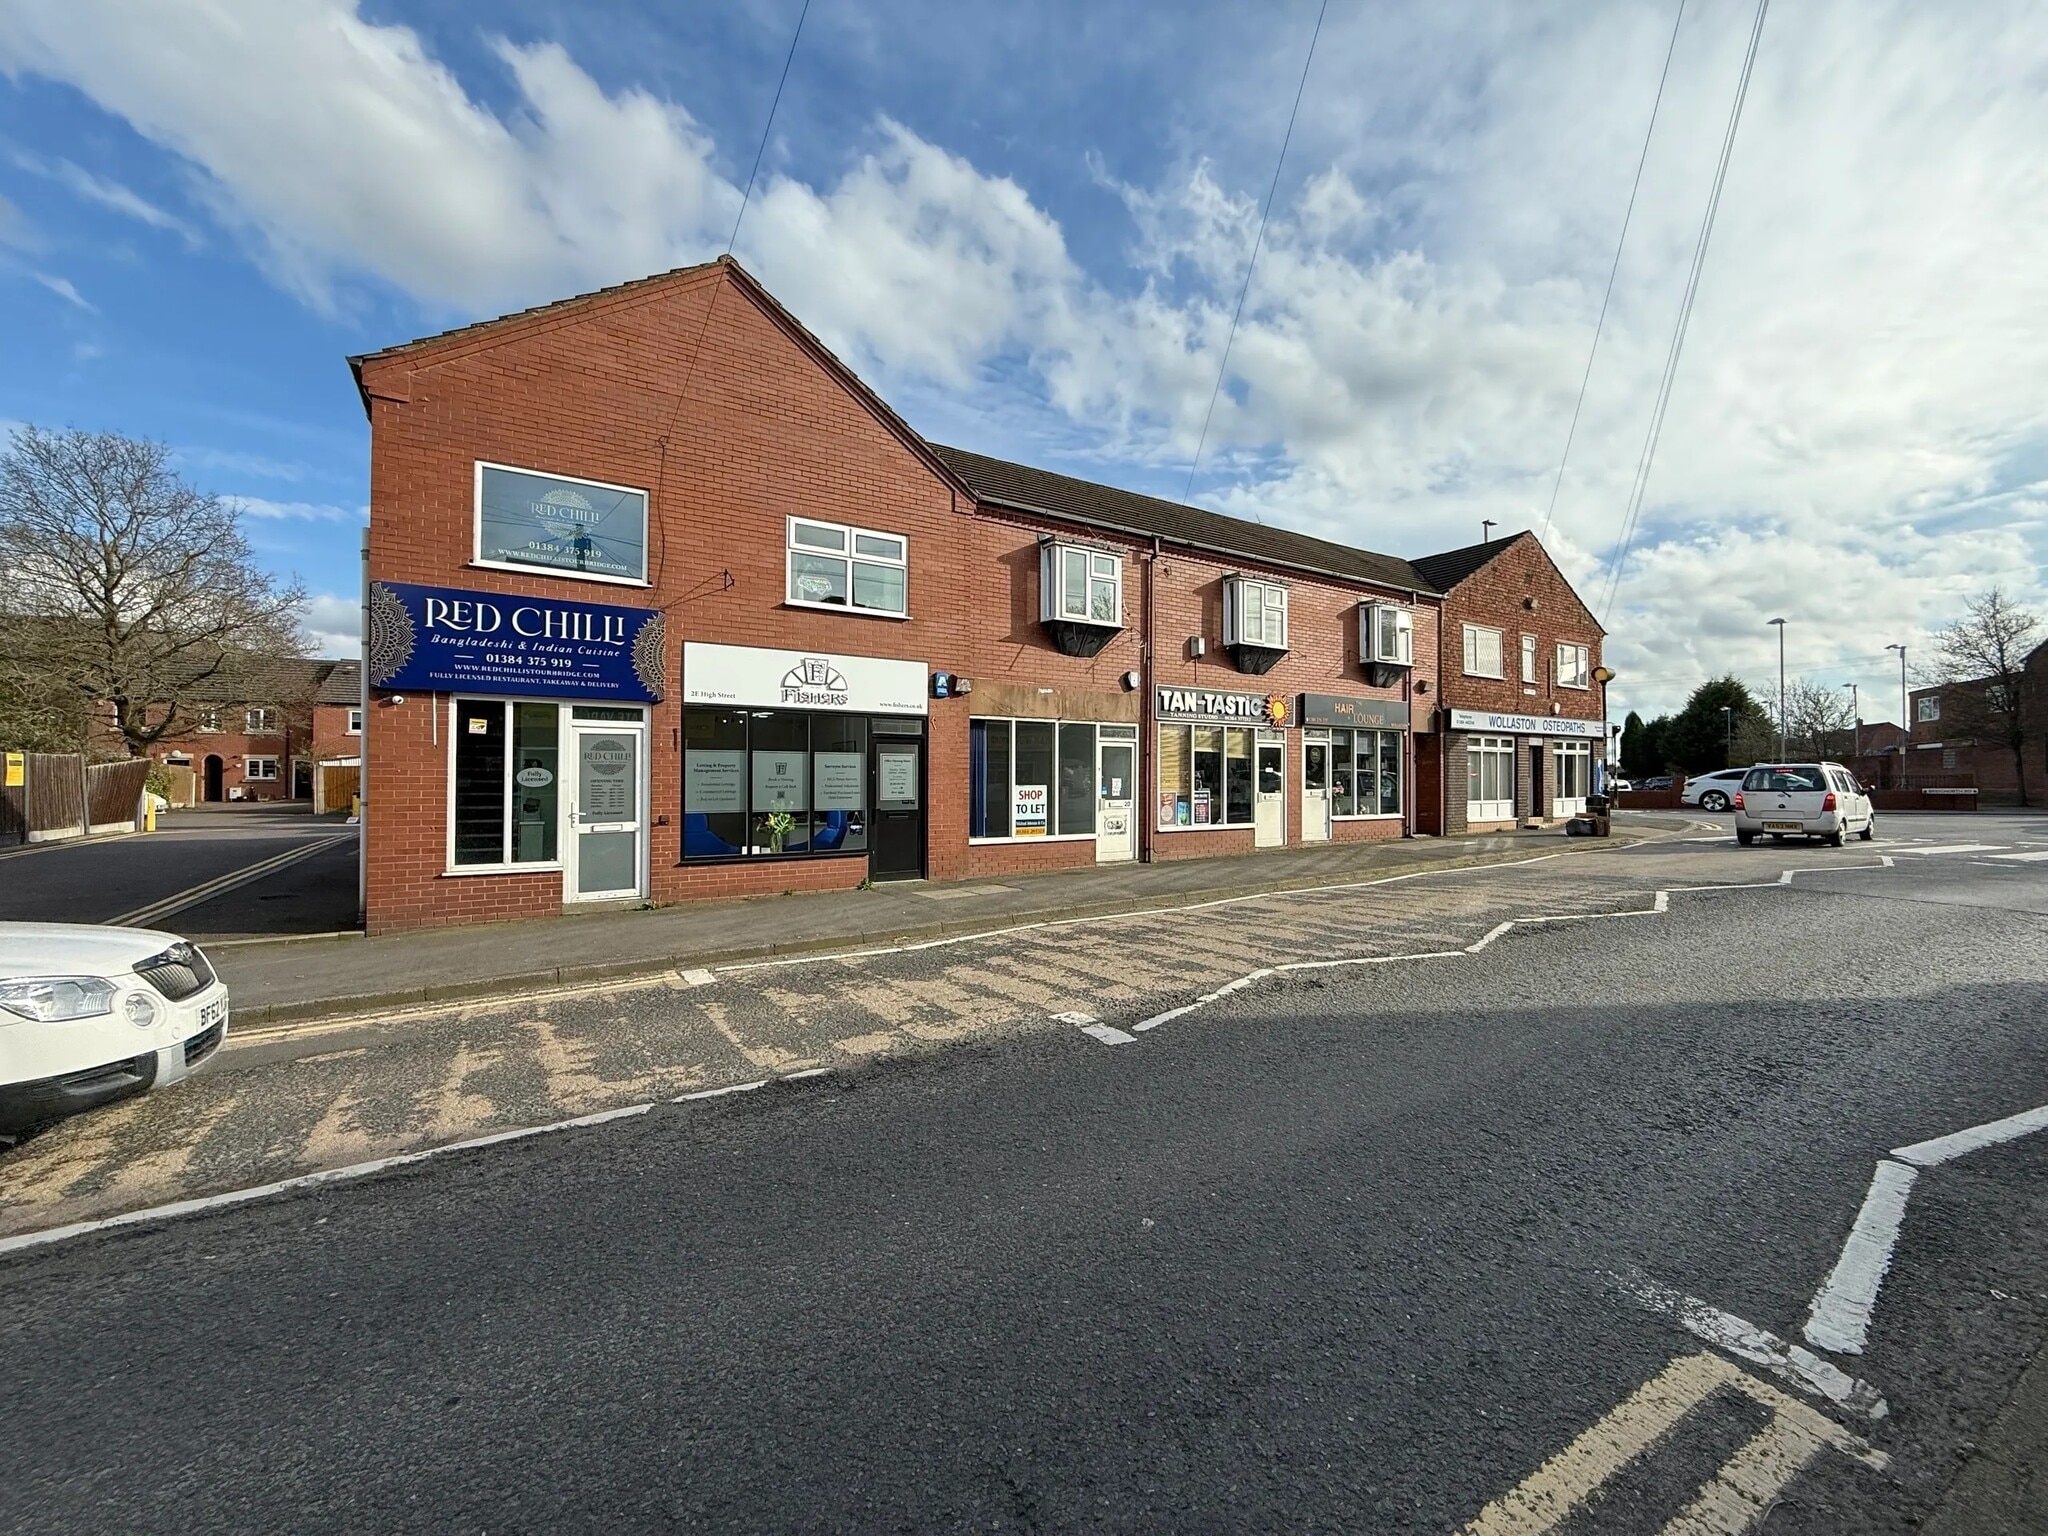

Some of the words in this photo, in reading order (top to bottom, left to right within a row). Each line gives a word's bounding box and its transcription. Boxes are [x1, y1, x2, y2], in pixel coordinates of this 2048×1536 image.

[531, 502, 556, 517] RED
[559, 507, 600, 524] CHILLI
[529, 541, 560, 553] 01384
[563, 546, 580, 555] 375
[583, 549, 602, 558] 919
[424, 597, 501, 633] RED
[511, 607, 625, 646] CHILLI
[430, 634, 514, 650] Bangladeshi
[518, 641, 527, 650] &
[532, 642, 572, 654] Indian
[577, 645, 620, 657] Cuisine
[486, 653, 522, 665] 01384
[527, 657, 547, 667] 375
[550, 658, 572, 668] 919
[429, 671, 454, 680] FULLY
[454, 672, 492, 682] LICENSED
[492, 675, 542, 686] RESTAURANT,
[542, 678, 580, 688] TAKEAWAY
[587, 681, 620, 690] DELIVERY
[700, 690, 716, 699] High
[717, 691, 736, 699] Street
[1334, 702, 1354, 714] HAIR
[1170, 712, 1197, 720] TANNING
[1197, 713, 1219, 721] STUDIO
[1353, 713, 1385, 725] LOUNGE
[1488, 715, 1537, 731] WOLLASTON
[1542, 719, 1586, 733] OSTEOPATHS
[583, 752, 602, 761] RED
[1018, 790, 1043, 801] SHOP
[1015, 803, 1028, 814] TO
[1030, 803, 1046, 814] LET
